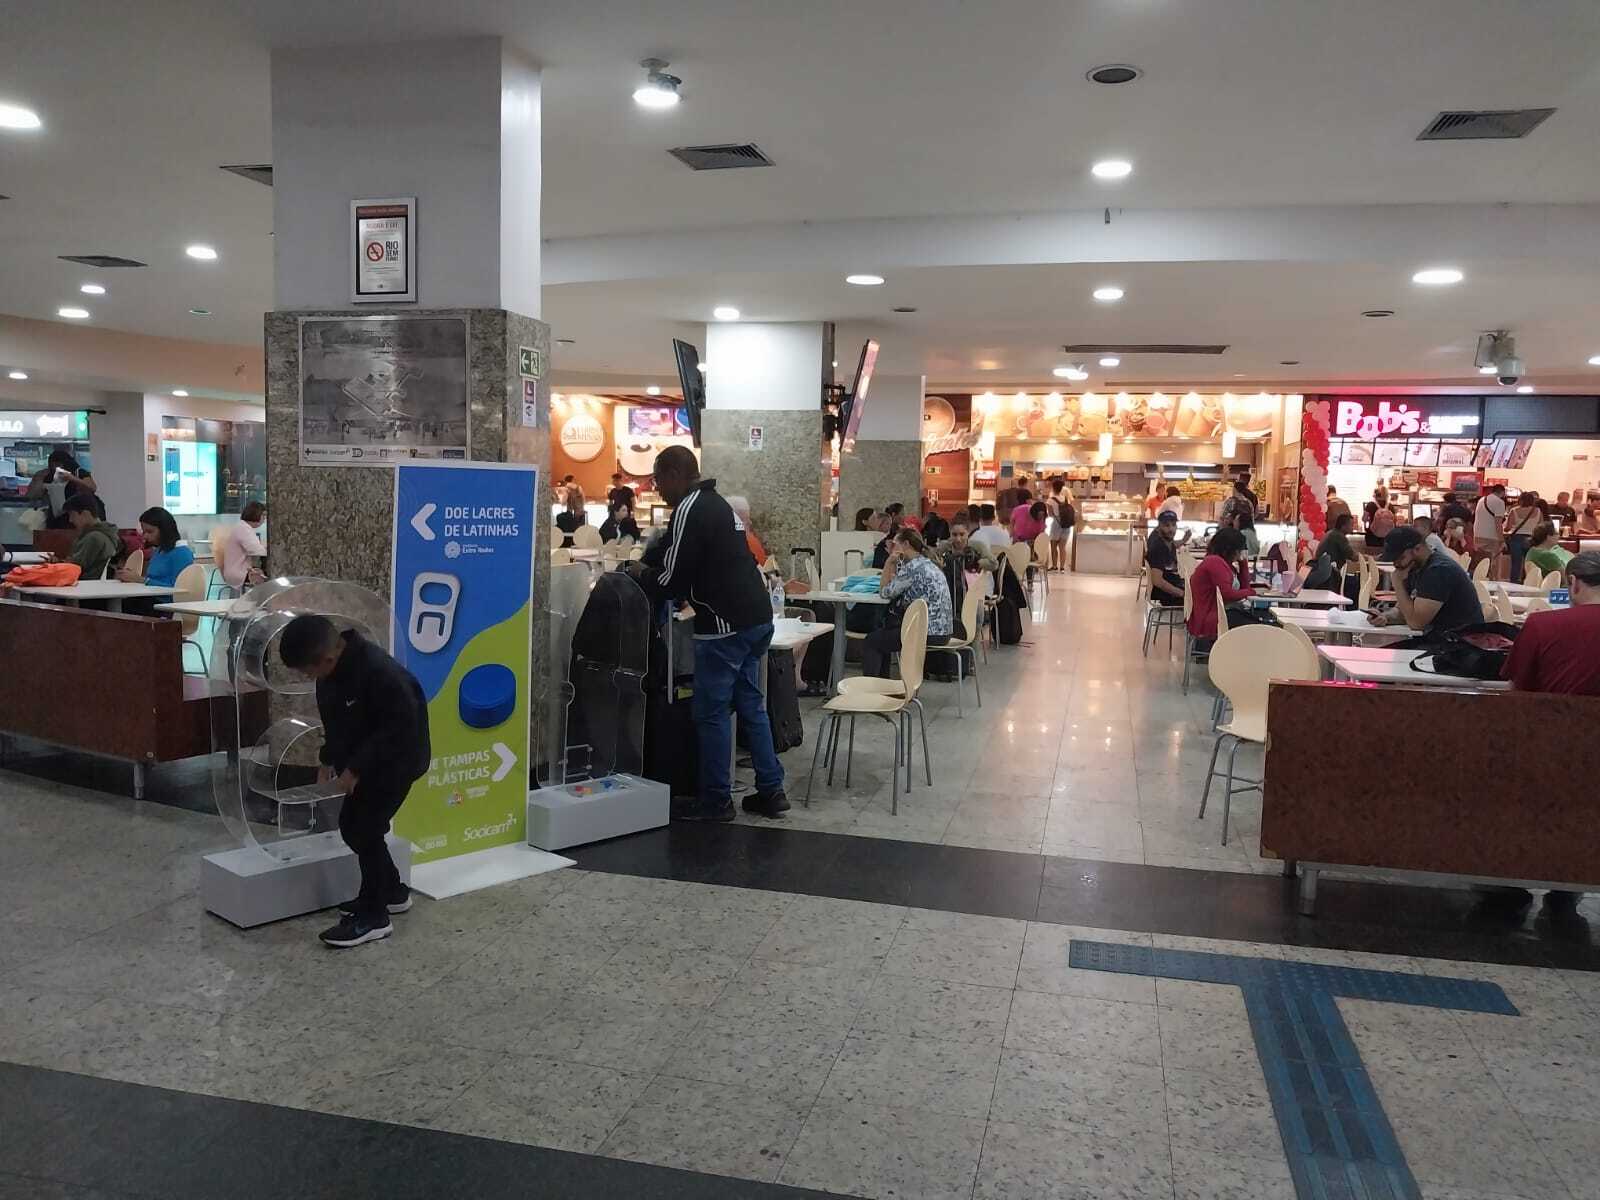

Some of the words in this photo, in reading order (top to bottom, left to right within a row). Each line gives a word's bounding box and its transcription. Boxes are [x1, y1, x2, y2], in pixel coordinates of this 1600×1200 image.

[385, 241, 399, 250] RIO
[1336, 401, 1420, 439] Bob's
[445, 507, 470, 519] DOE
[472, 507, 515, 519] LACRES
[444, 525, 460, 537] DE
[463, 525, 519, 537] LATINHAS
[443, 750, 490, 769] TAMPAS
